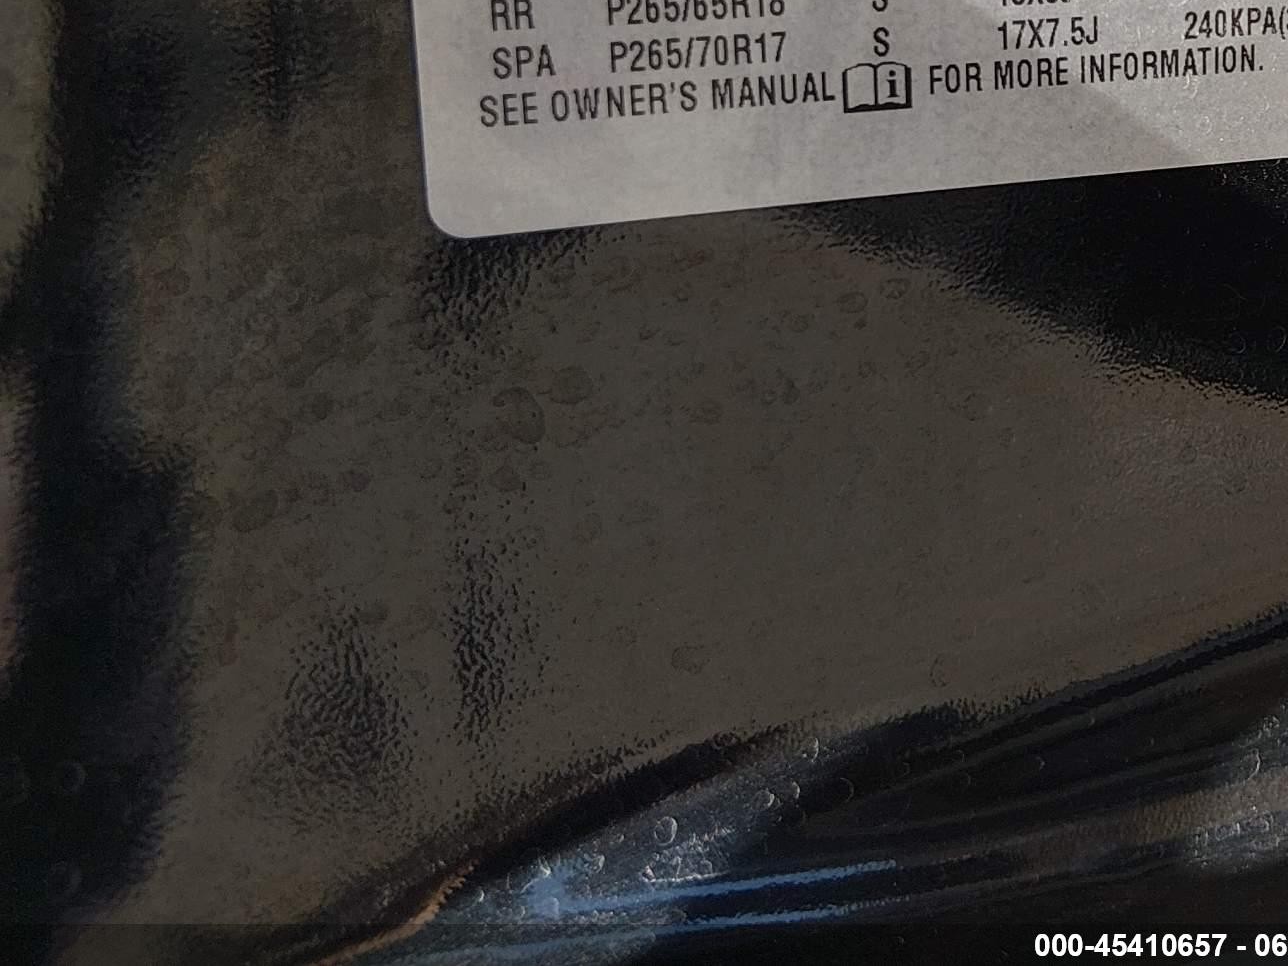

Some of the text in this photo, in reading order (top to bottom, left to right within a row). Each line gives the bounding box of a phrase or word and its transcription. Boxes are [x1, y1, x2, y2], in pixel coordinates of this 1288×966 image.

[492, 45, 556, 80] SPA
[609, 31, 786, 73] P265/70R17
[873, 27, 890, 57] S
[997, 16, 1099, 51] 17X7.5J
[480, 44, 1264, 128] SEE OWNER'S MANUAL FOR MORE INFORMATION.
